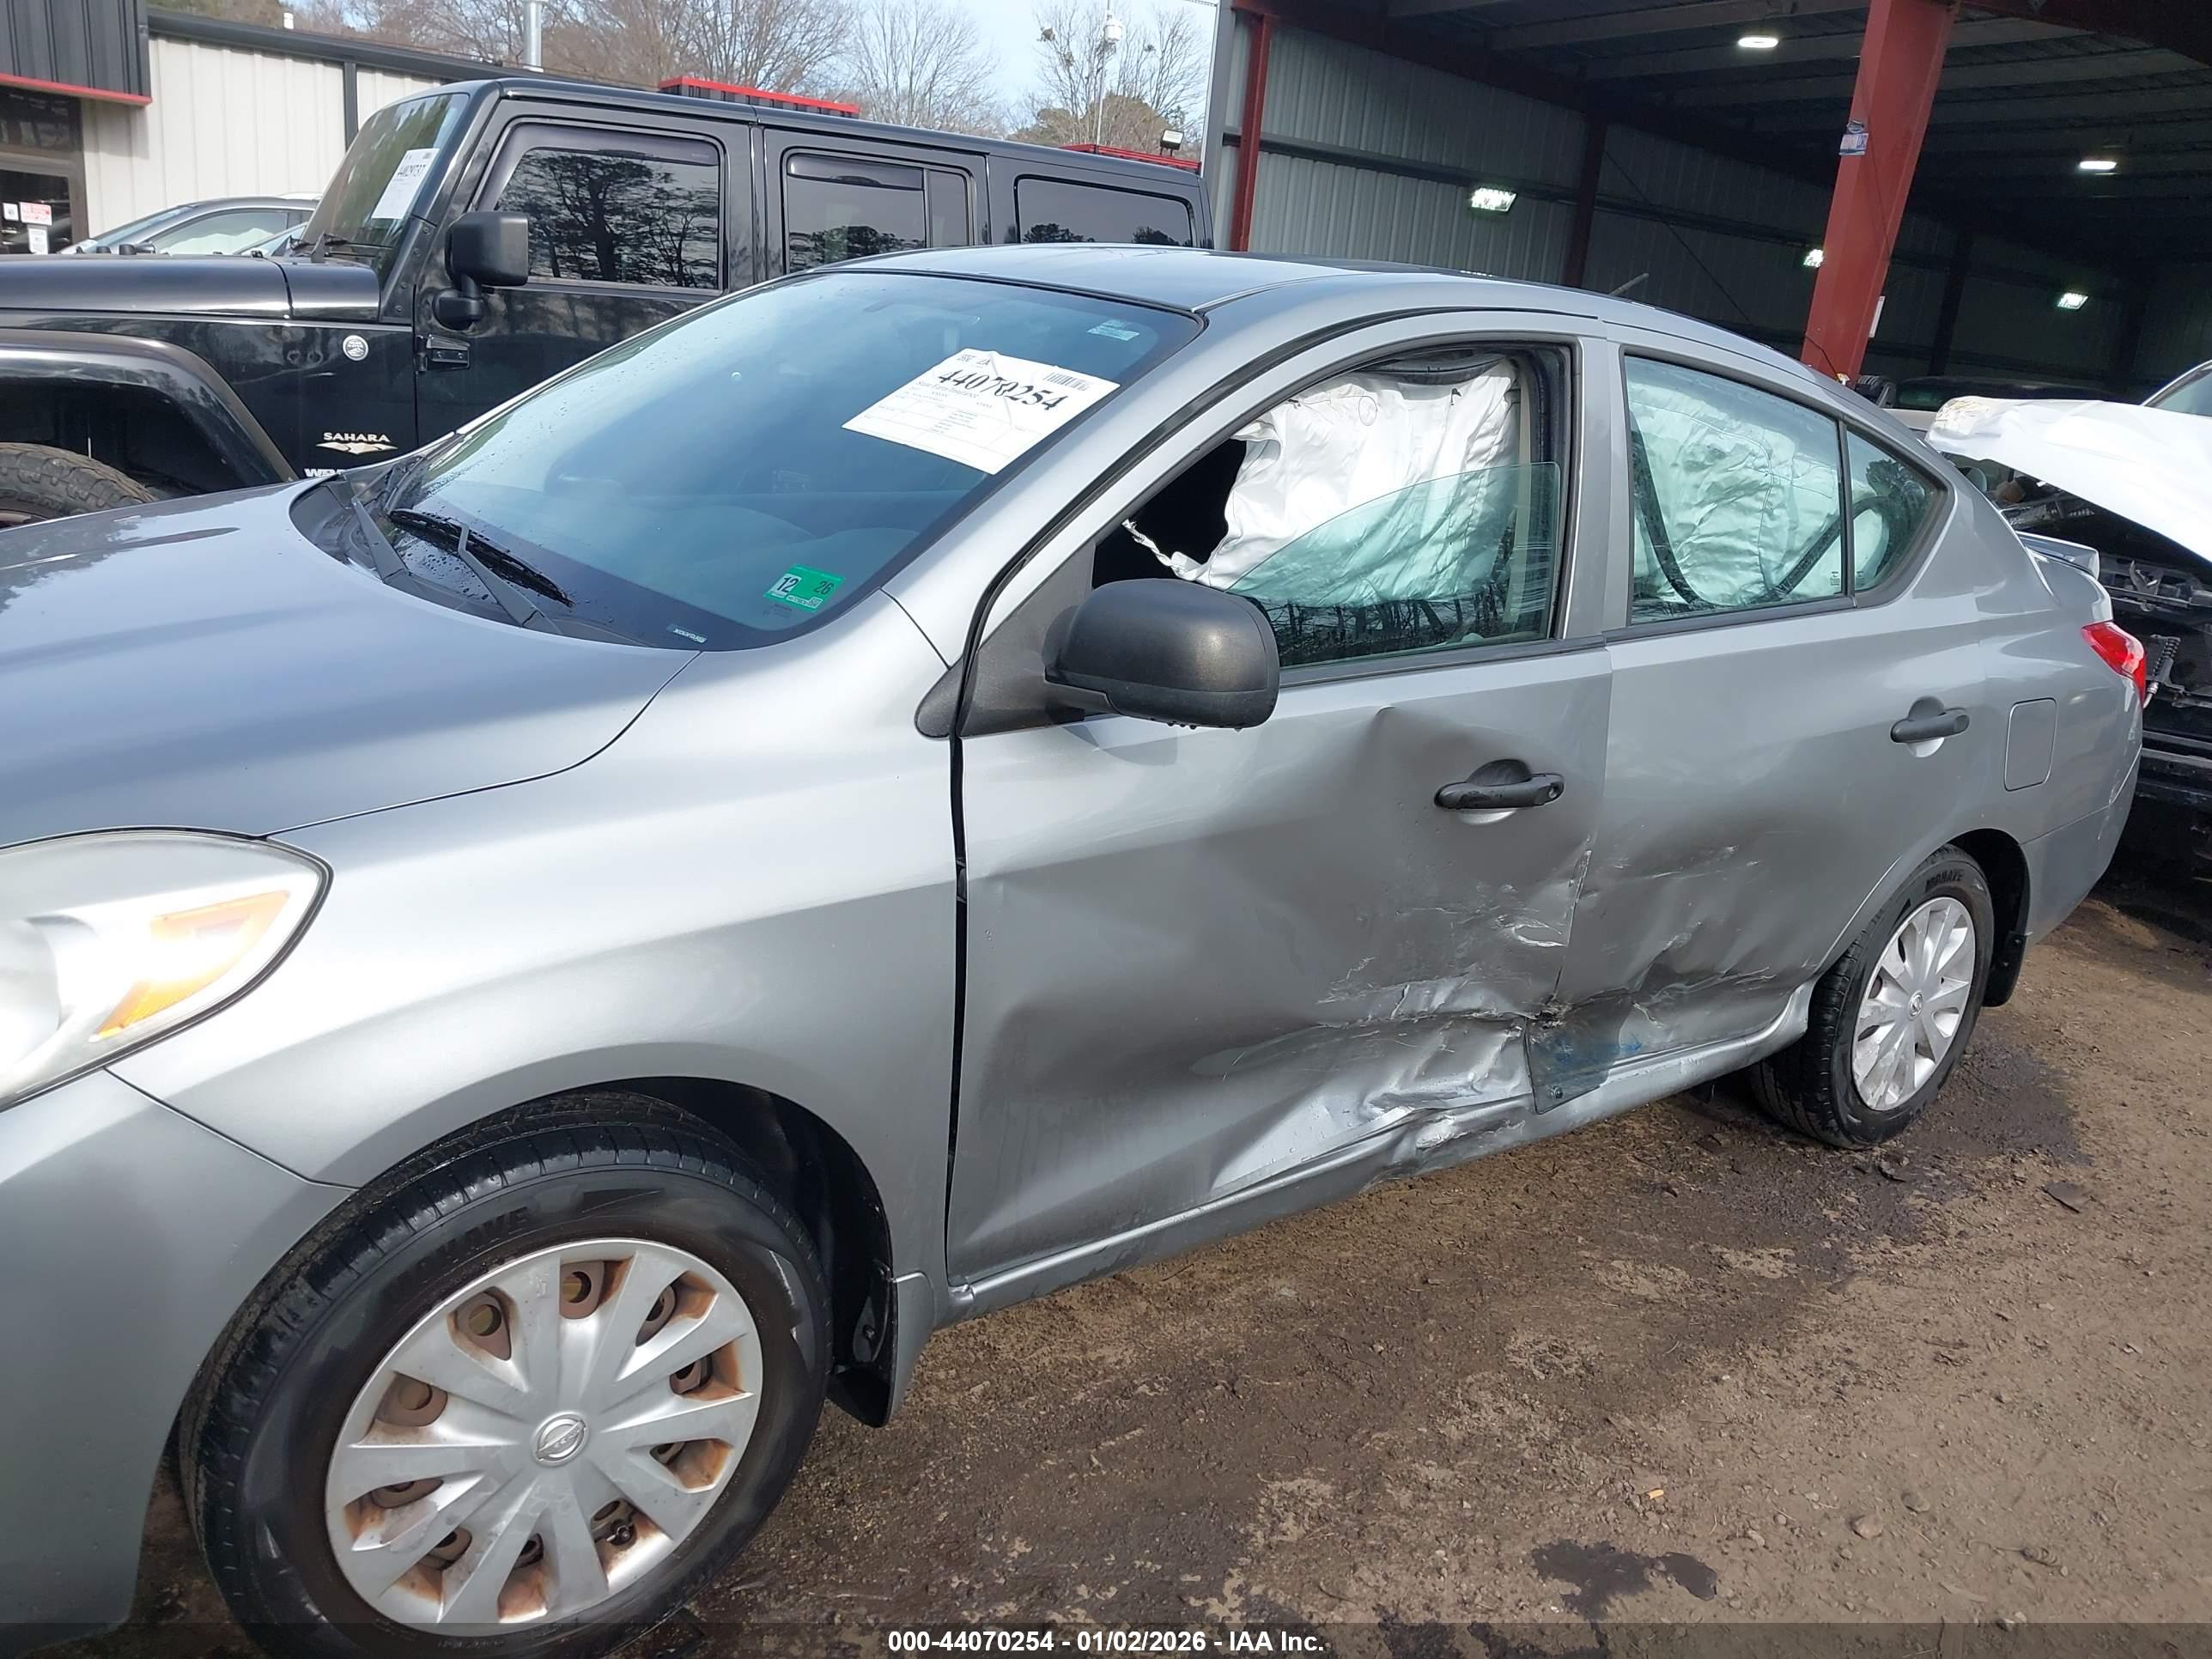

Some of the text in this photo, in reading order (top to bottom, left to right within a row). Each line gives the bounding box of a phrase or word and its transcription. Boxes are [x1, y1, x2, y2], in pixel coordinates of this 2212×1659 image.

[938, 369, 1068, 410] 44070254
[323, 432, 391, 442] SAHARA
[777, 577, 835, 594] 12 26
